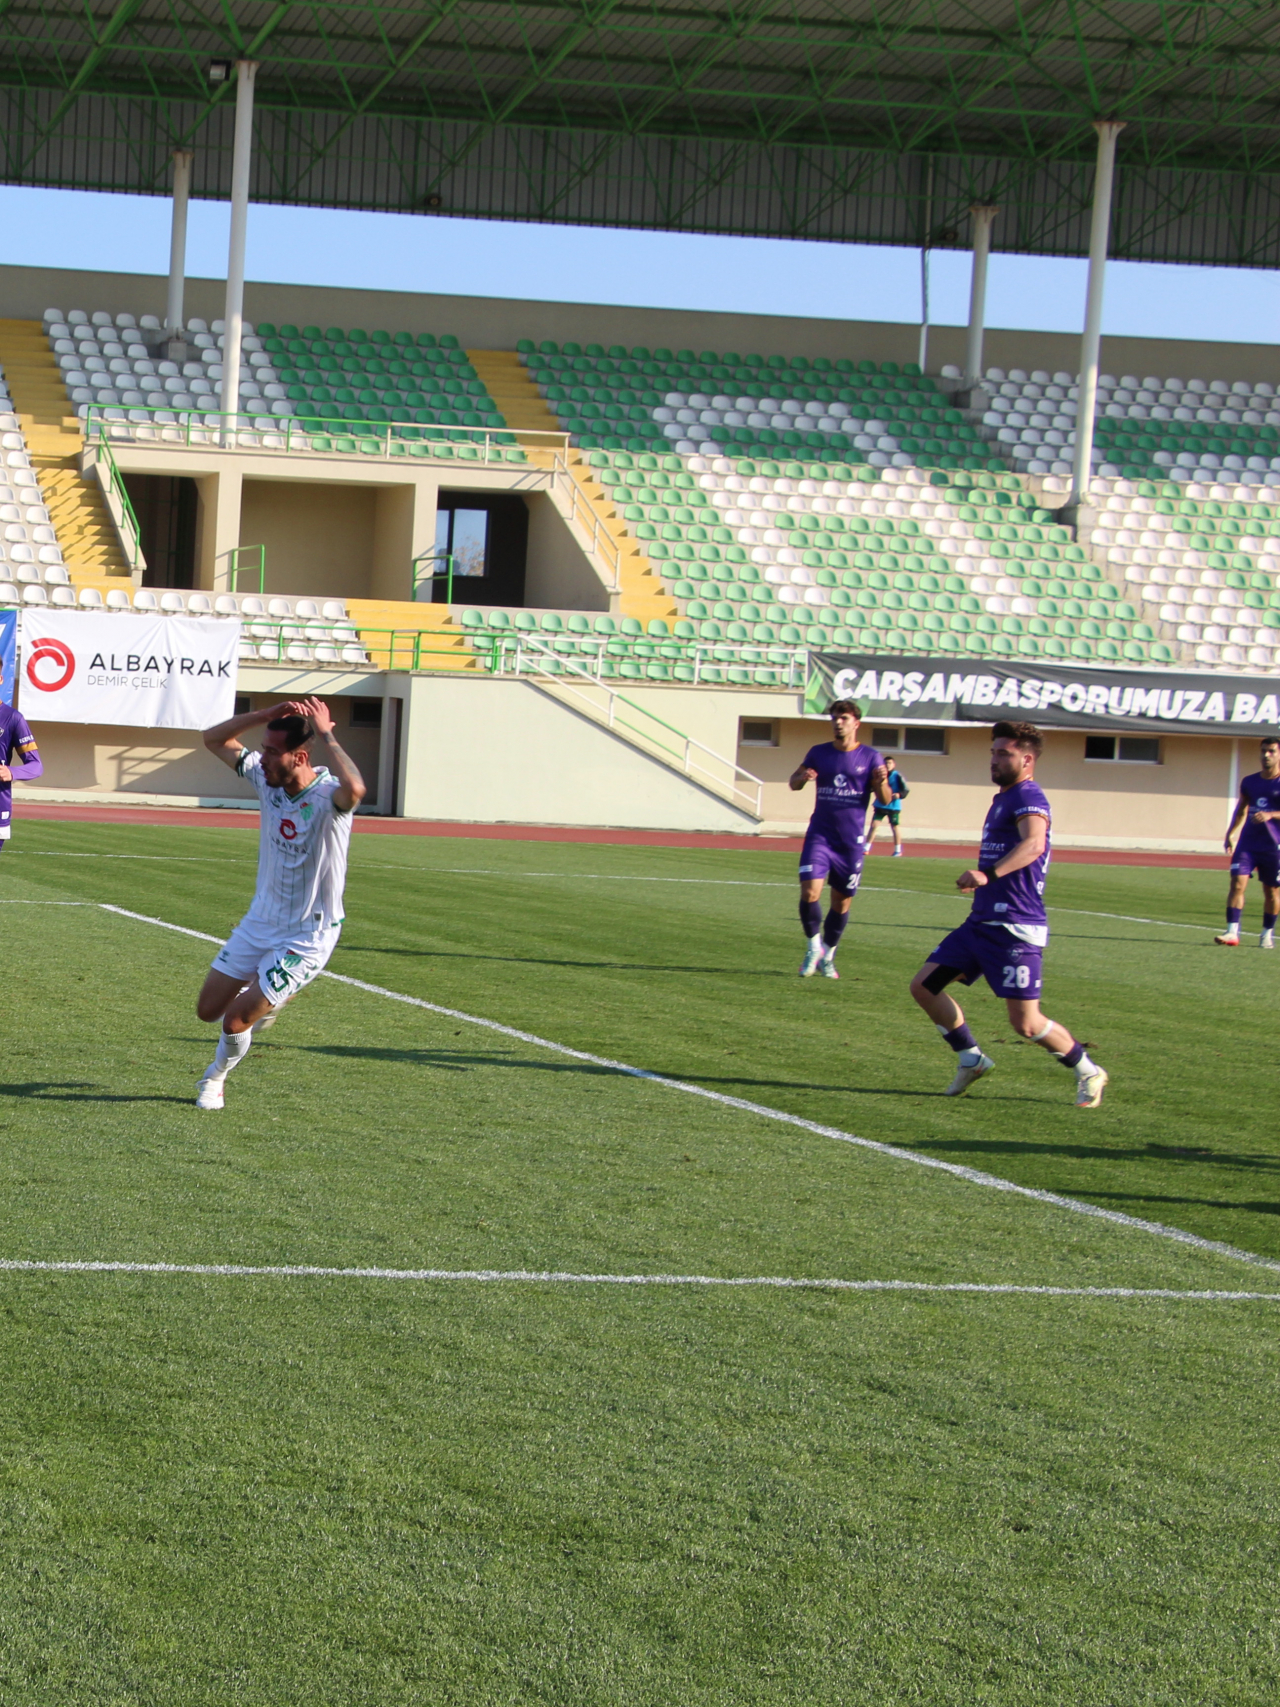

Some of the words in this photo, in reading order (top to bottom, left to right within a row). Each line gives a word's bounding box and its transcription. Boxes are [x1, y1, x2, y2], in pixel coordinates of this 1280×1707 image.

[89, 652, 231, 678] ALBAYRAK
[87, 674, 128, 687] DEMİR
[131, 676, 168, 690] ÇELİK
[833, 668, 1225, 722] ÇARŞAMBASPORUMUZA
[1230, 692, 1280, 729] BA
[1002, 964, 1031, 989] 28
